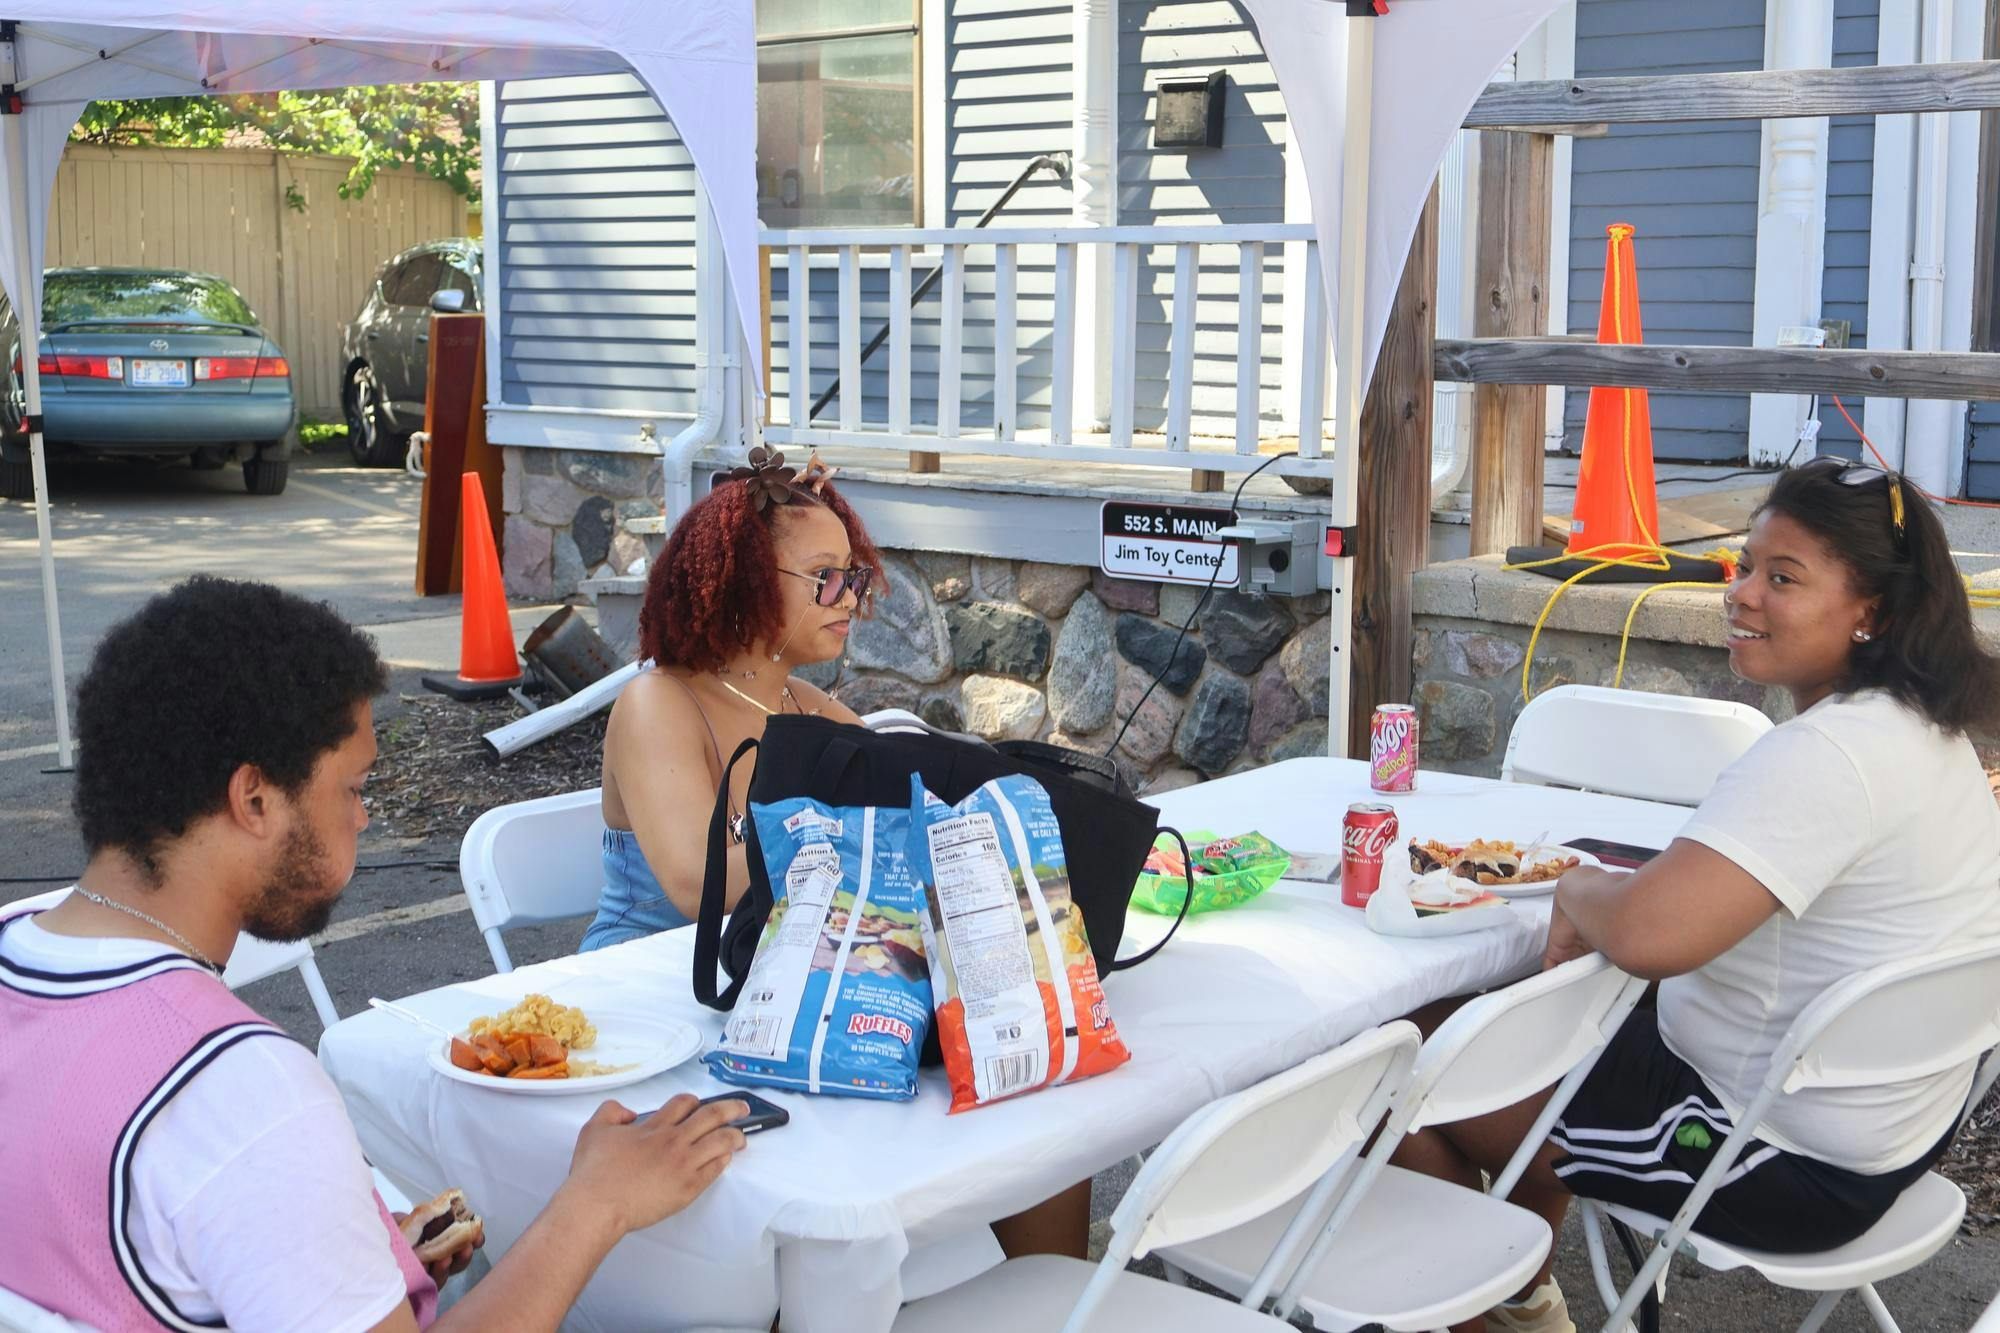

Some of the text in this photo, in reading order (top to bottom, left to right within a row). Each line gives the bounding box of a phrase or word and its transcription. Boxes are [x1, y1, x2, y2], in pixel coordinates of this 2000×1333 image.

[1124, 515, 1216, 536] 552 S. MAIN
[1115, 544, 1226, 567] Jim Toy Center
[932, 817, 988, 836] Nutrition Facts
[796, 849, 828, 858] utrition
[936, 842, 998, 863] Calories 160
[849, 1013, 912, 1044] RUFFLES
[865, 1046, 902, 1060] RUFFLES.COM
